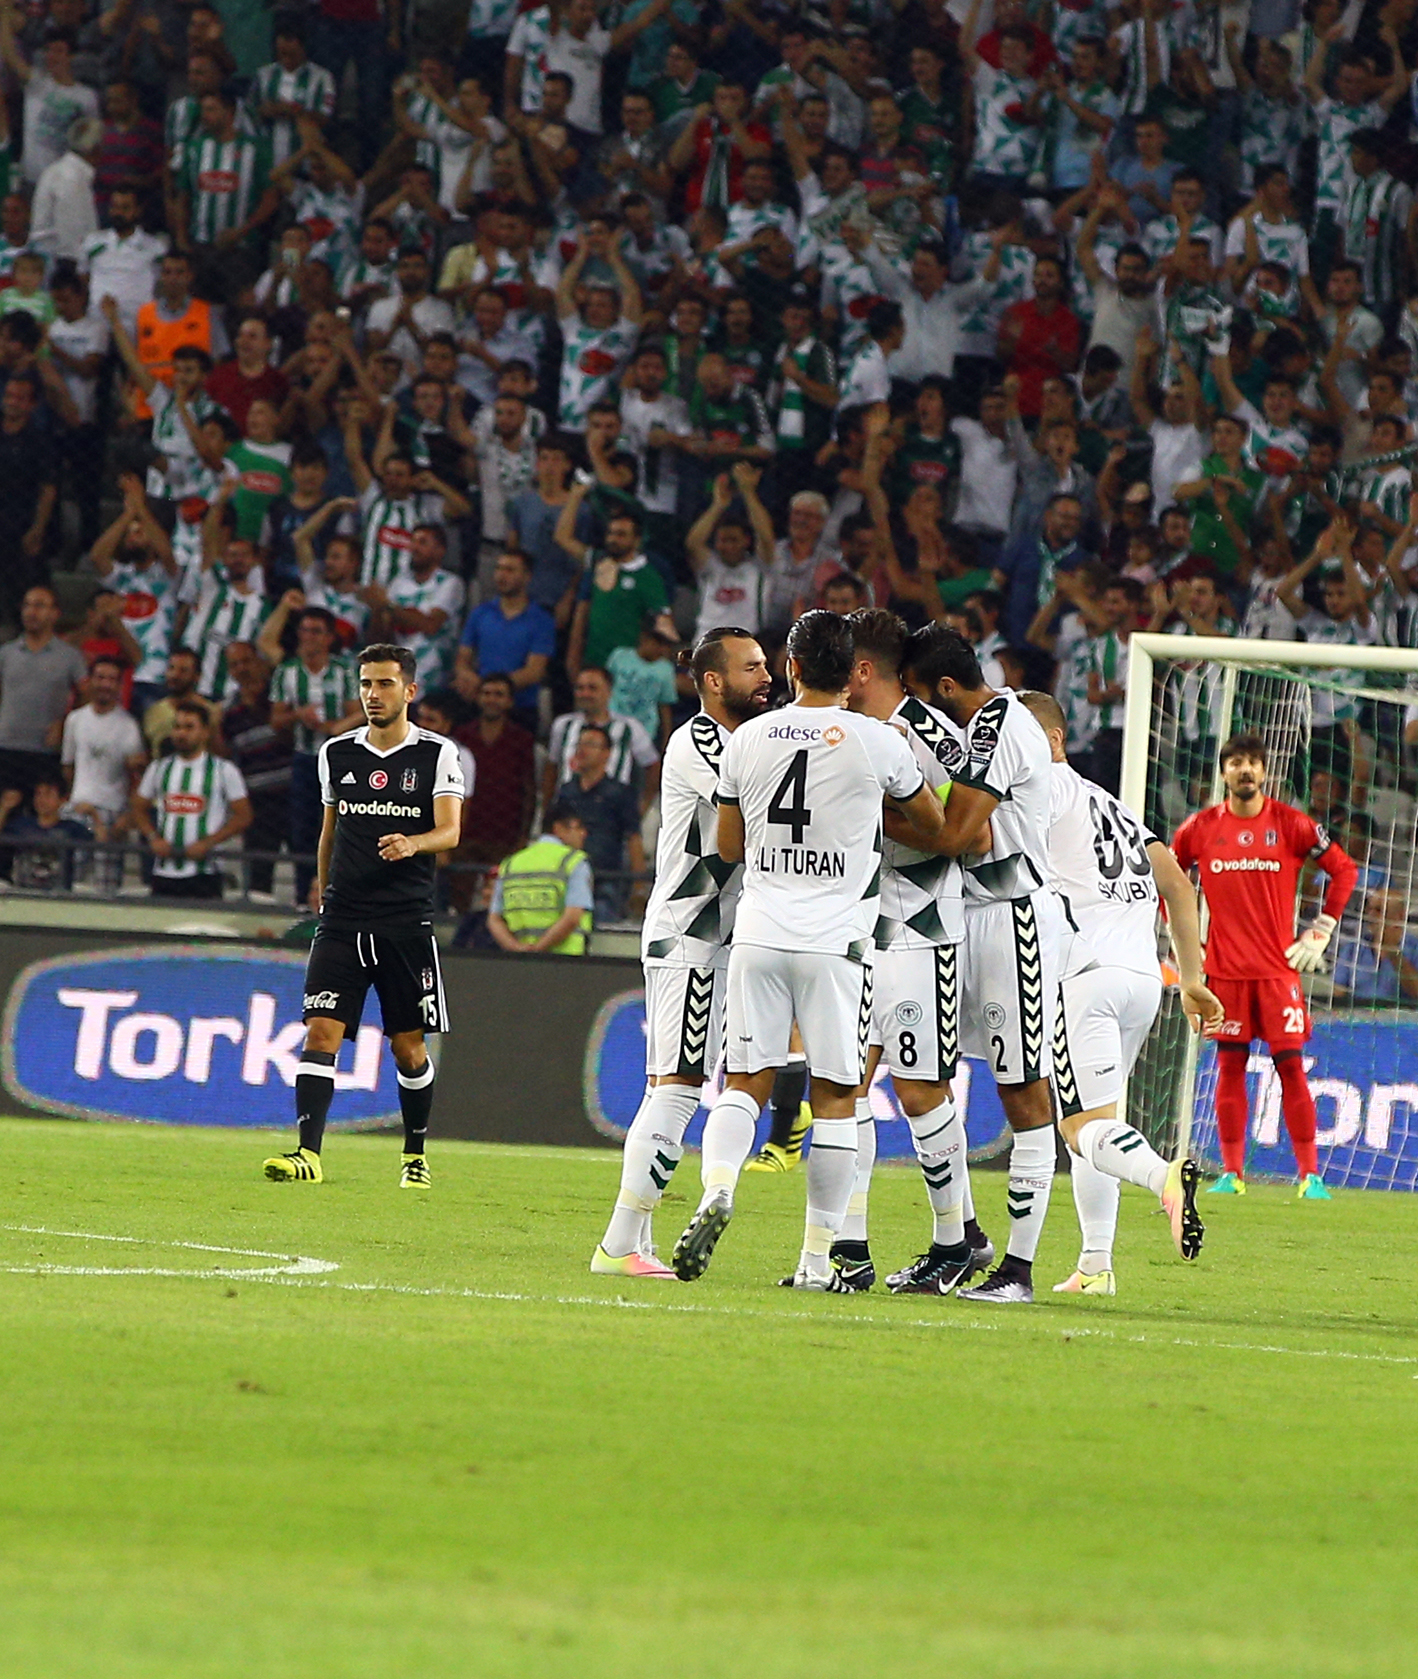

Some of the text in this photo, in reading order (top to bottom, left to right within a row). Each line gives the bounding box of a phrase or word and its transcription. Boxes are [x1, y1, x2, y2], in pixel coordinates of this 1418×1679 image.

[768, 725, 821, 741] adese
[349, 800, 421, 818] vodafone
[767, 748, 812, 845] 4
[781, 848, 845, 877] TURAN
[1223, 857, 1281, 873] vodafone
[417, 994, 438, 1027] 15
[1282, 1006, 1305, 1034] 29
[57, 987, 384, 1092] Torku
[899, 1030, 919, 1068] 8
[991, 1035, 1008, 1073] 2
